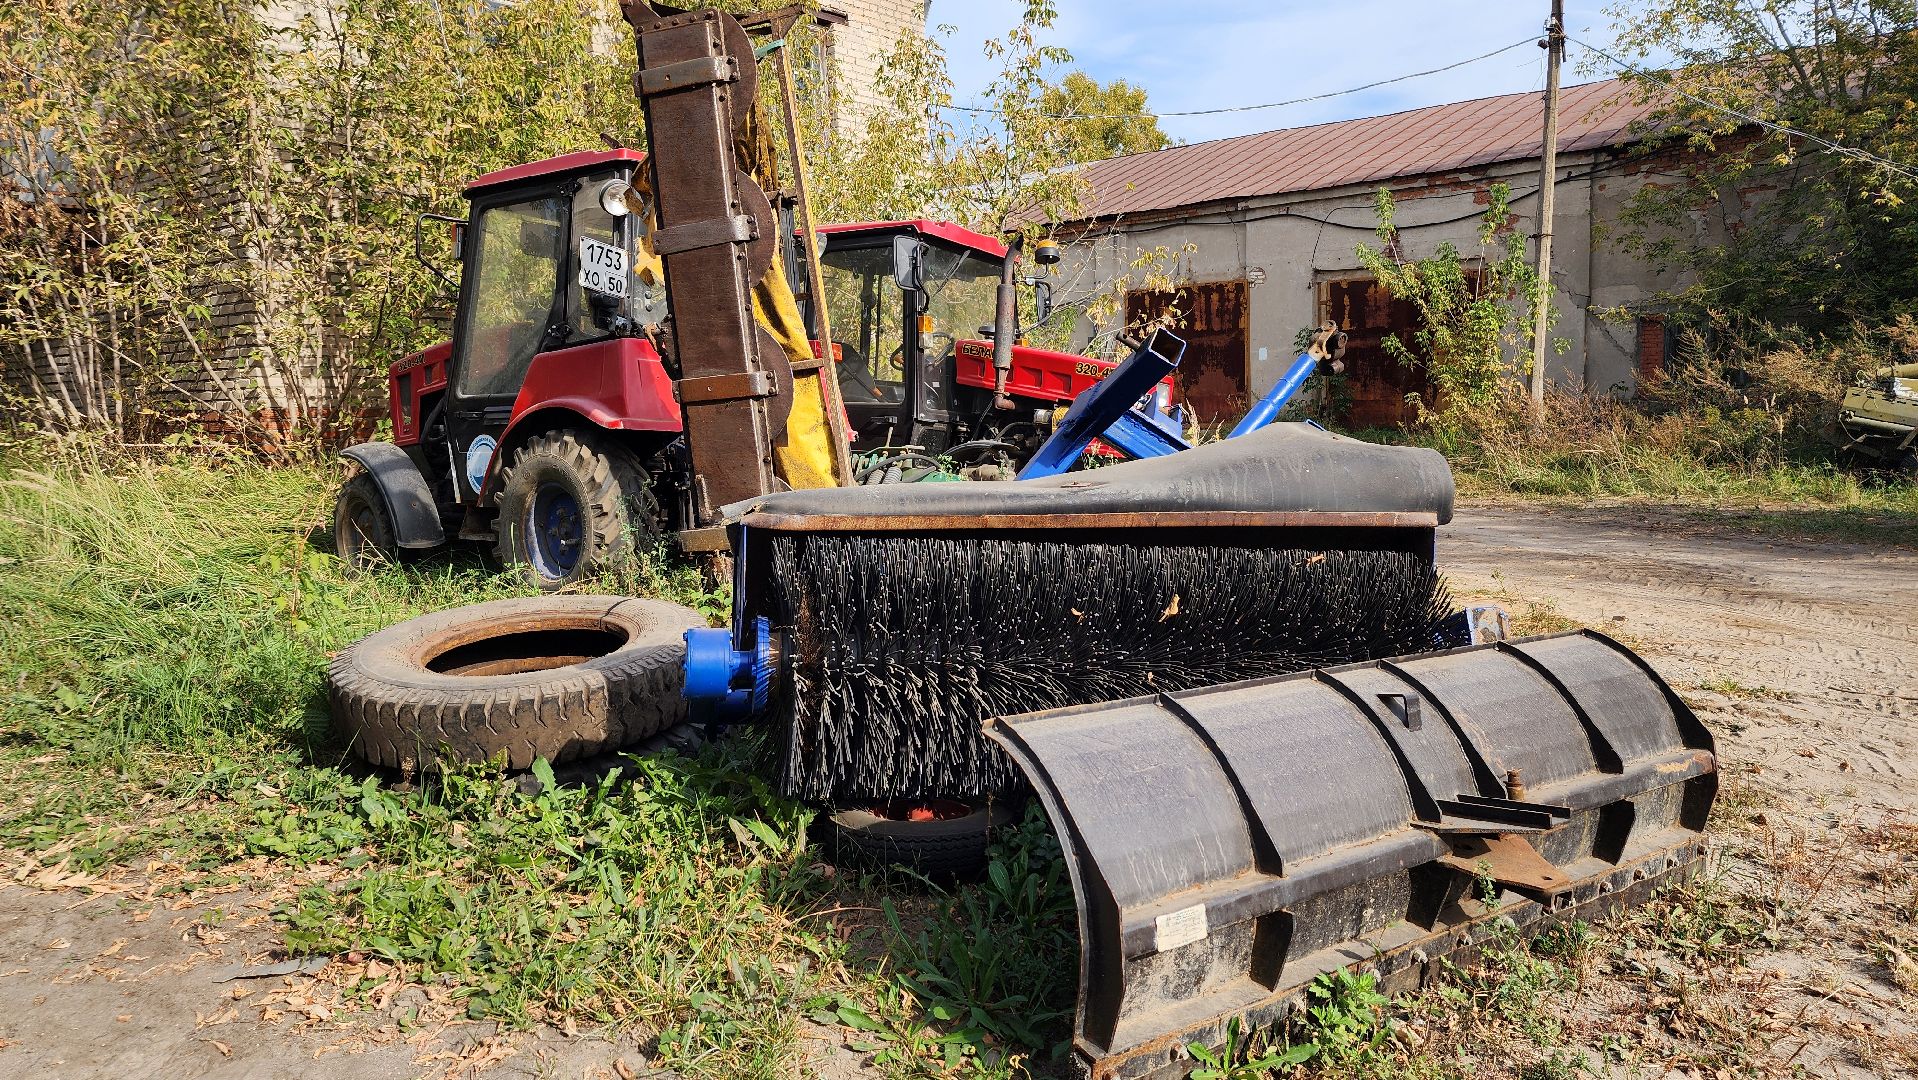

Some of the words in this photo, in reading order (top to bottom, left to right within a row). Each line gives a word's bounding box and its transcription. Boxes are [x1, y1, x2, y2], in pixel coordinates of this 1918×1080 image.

[587, 244, 621, 270] 1753
[583, 268, 599, 286] ХО
[608, 277, 622, 293] 50
